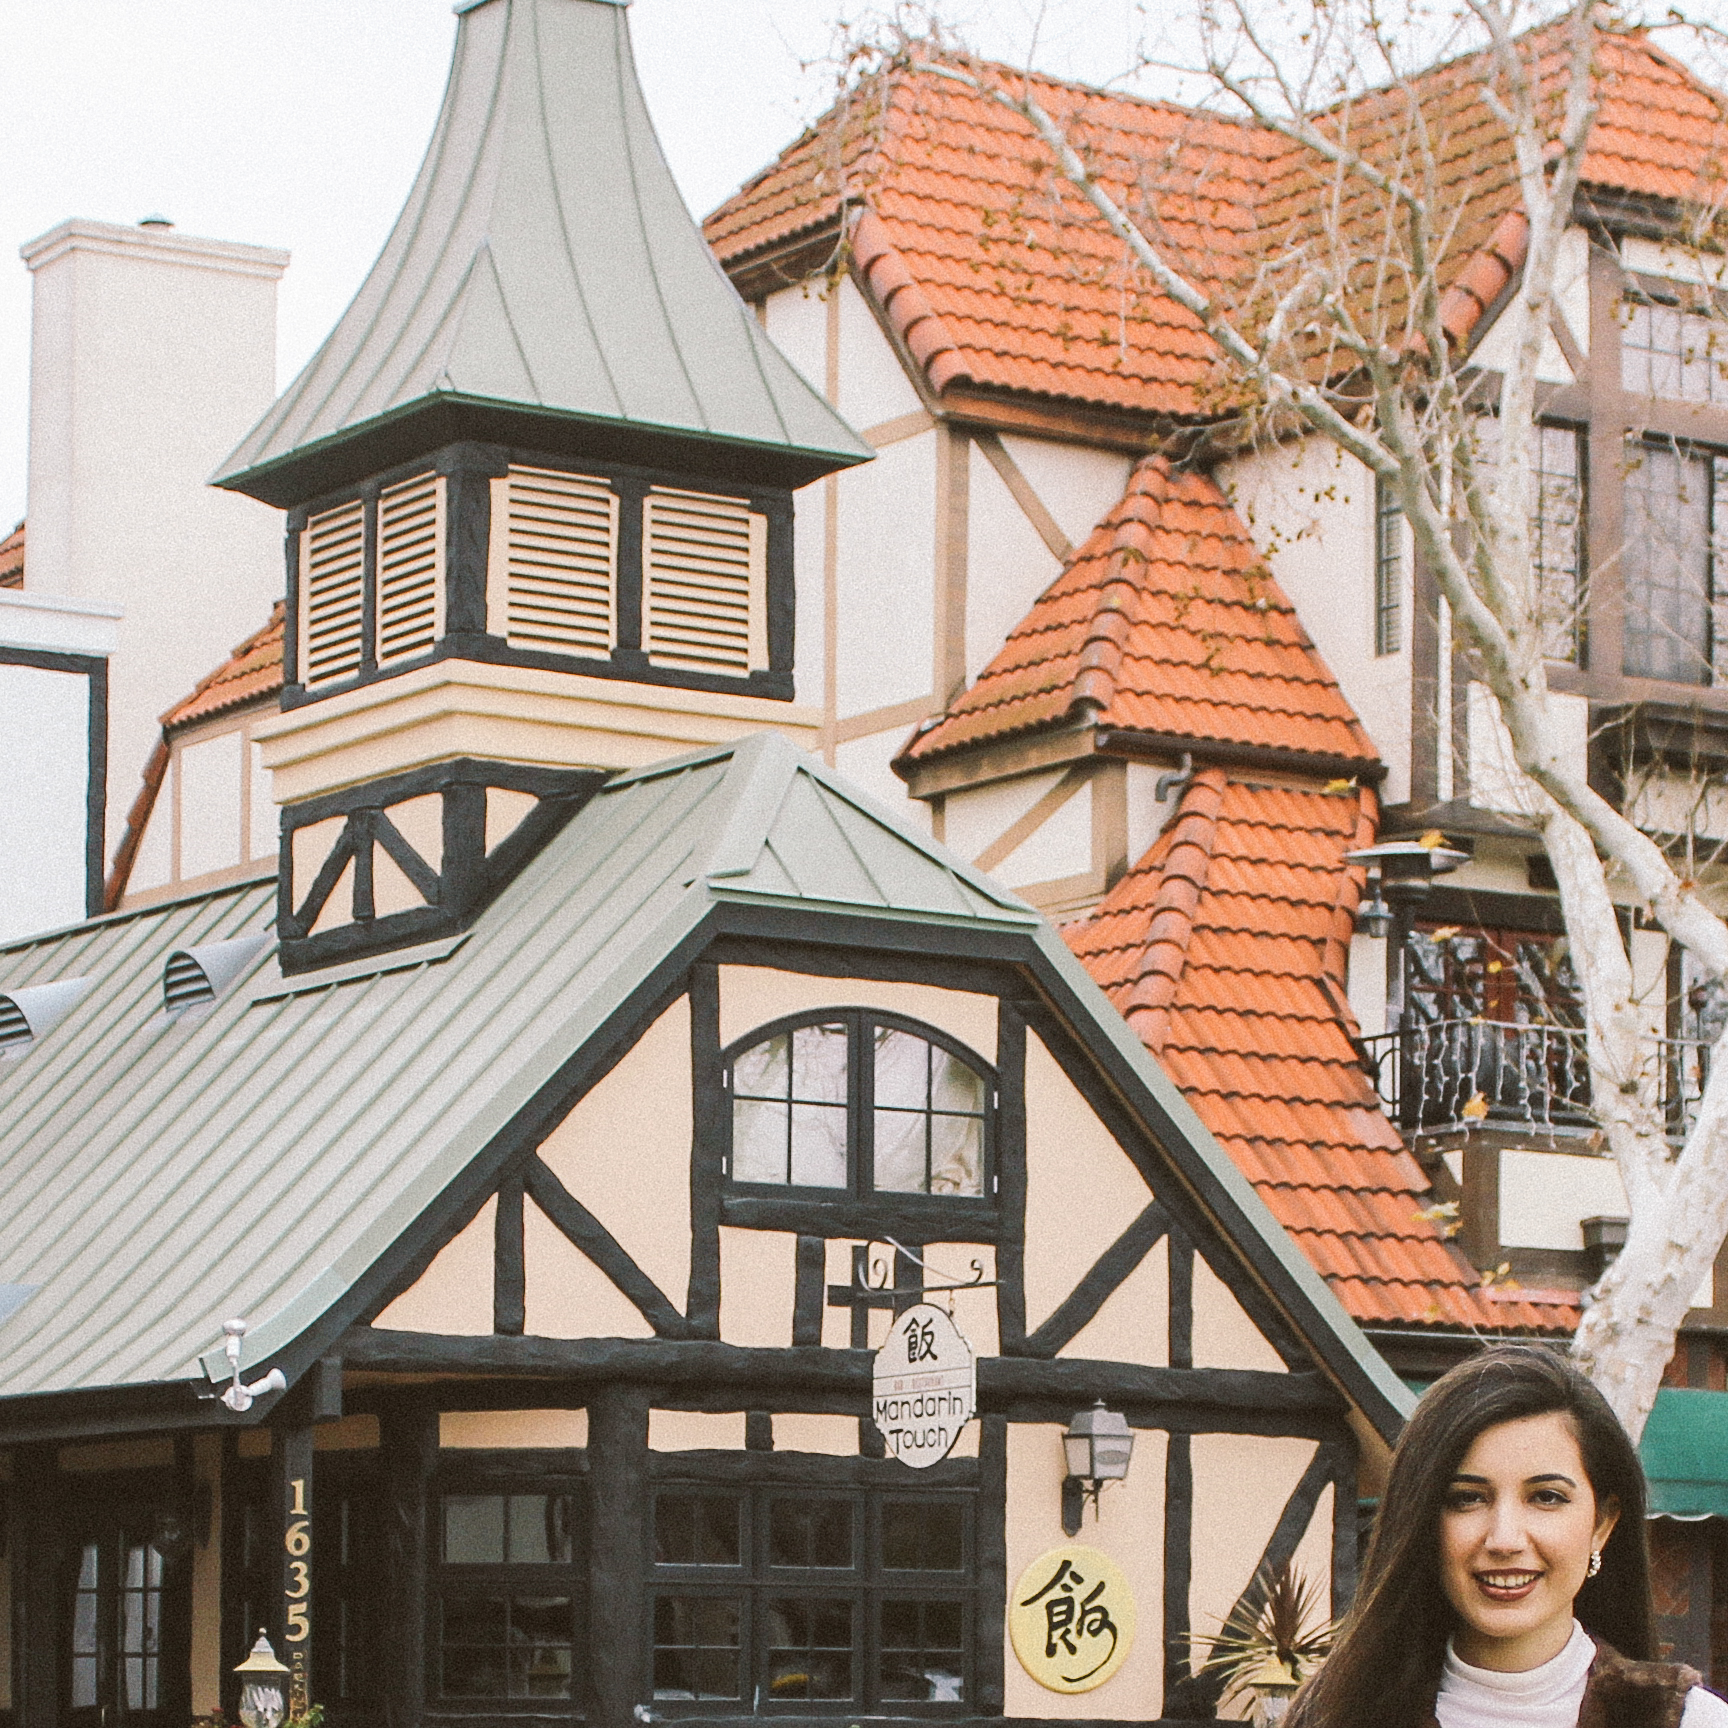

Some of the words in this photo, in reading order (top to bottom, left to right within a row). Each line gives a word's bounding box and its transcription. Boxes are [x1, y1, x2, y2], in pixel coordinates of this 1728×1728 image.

[903, 1317, 938, 1364] 飯
[875, 1391, 964, 1424] Mandarin
[888, 1426, 949, 1455] Touch
[284, 1479, 311, 1643] 1635
